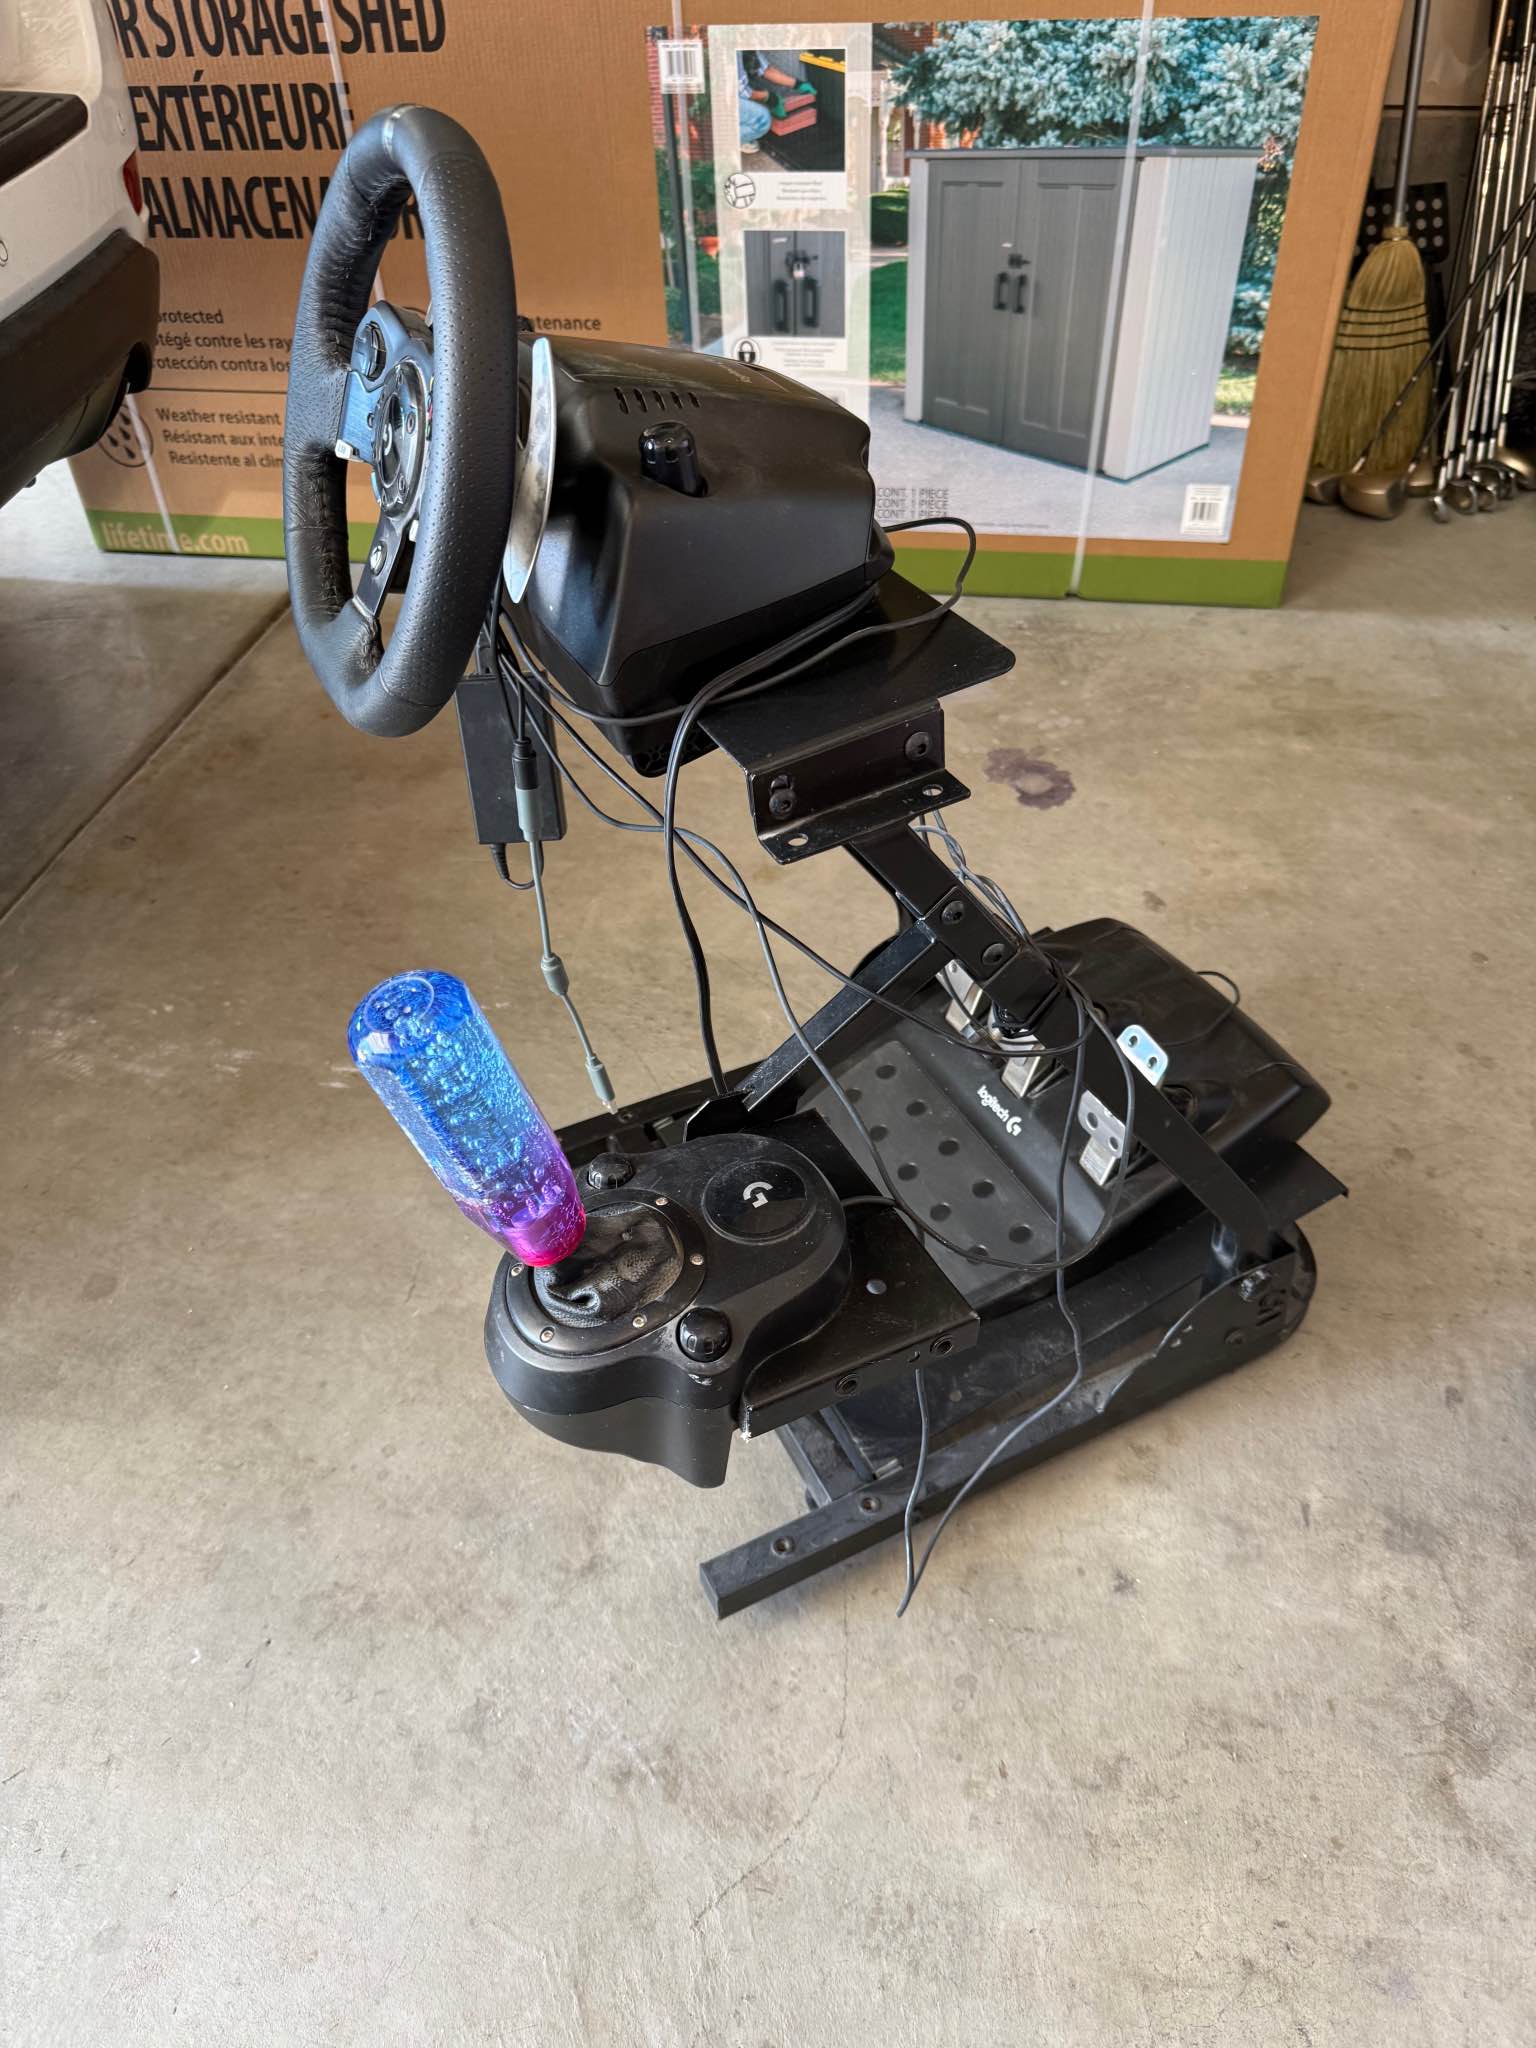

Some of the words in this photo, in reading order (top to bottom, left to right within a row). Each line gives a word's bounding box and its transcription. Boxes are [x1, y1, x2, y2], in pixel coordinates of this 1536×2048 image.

[106, 0, 150, 58] R
[145, 0, 331, 58] STORAGE
[332, 0, 446, 53] SHED
[157, 309, 224, 324] rotected
[195, 335, 243, 348] contre
[244, 332, 266, 349] les
[220, 359, 268, 372] contra
[155, 408, 216, 422] Weather
[219, 410, 281, 425] resistant
[162, 429, 227, 445] Résistant
[230, 435, 256, 446] aux
[168, 450, 241, 467] Resistente
[244, 453, 257, 467] al
[101, 521, 249, 553] lifetime.com
[977, 1084, 1010, 1122] logitech
